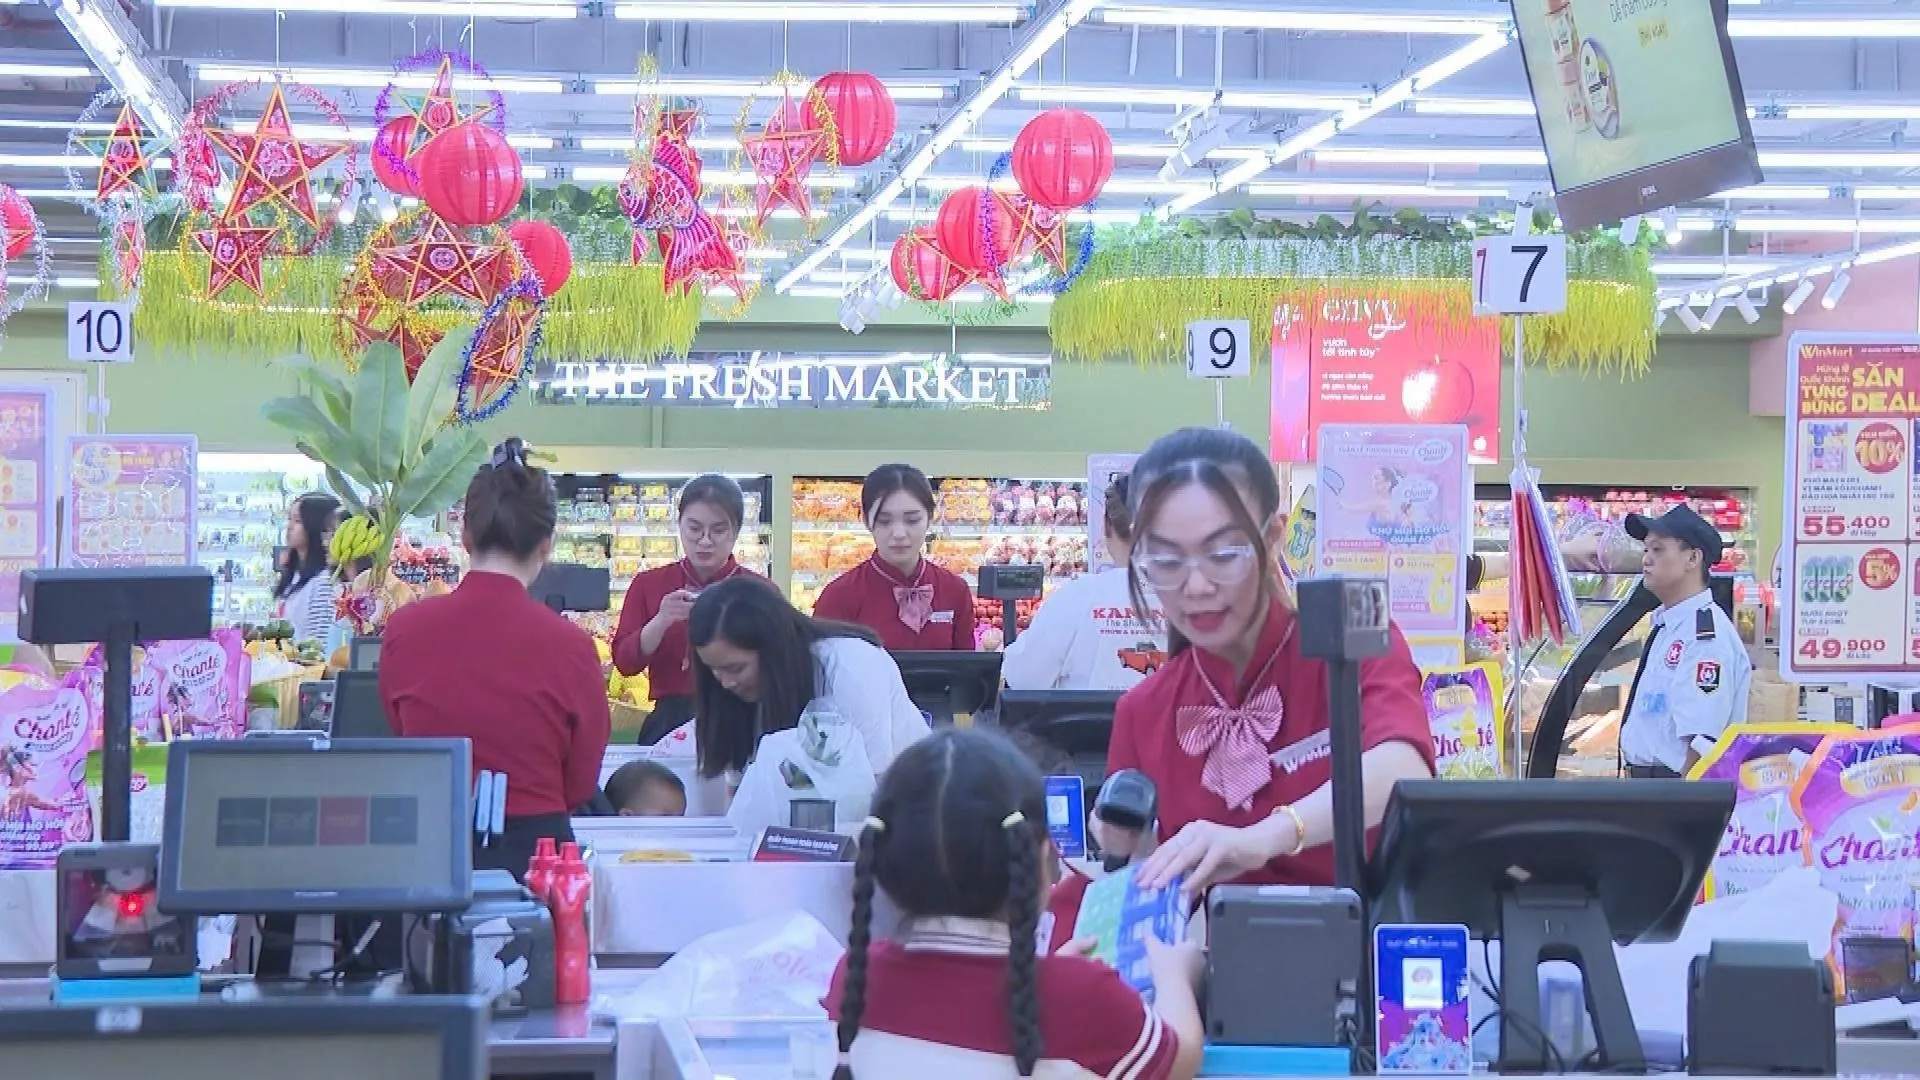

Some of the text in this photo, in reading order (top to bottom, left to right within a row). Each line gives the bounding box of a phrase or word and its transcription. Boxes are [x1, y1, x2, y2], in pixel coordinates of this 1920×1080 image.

[1511, 245, 1548, 302] 7
[76, 309, 122, 353] 10
[1209, 327, 1236, 369] 9
[1801, 345, 1853, 359] WinMart
[555, 360, 1026, 403] THE FRESH MARKET
[1852, 361, 1904, 387] SĂN
[1852, 391, 1920, 413] DEAL
[1856, 440, 1904, 467] 10%
[14, 705, 81, 741] Chanté
